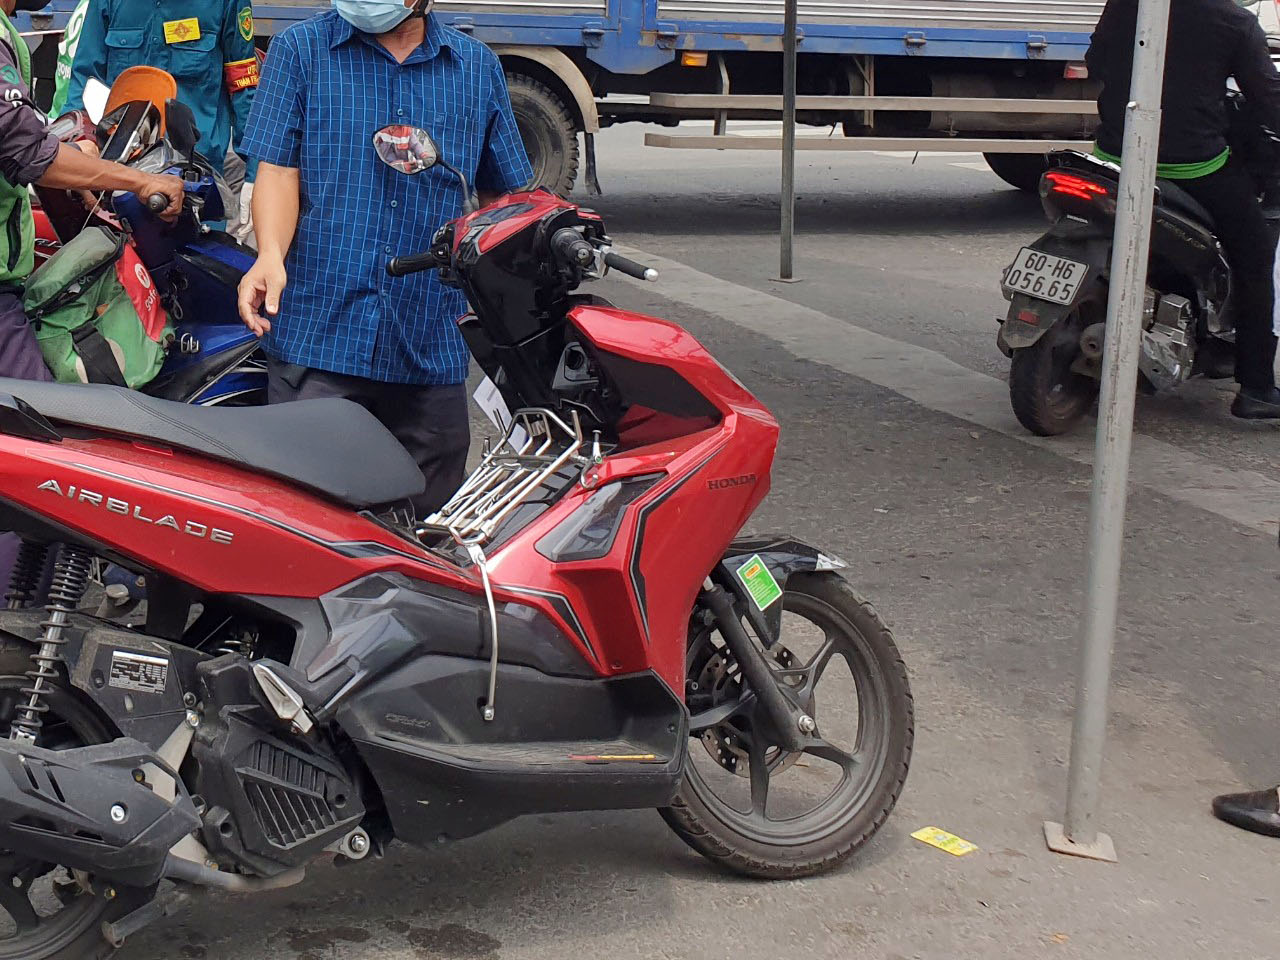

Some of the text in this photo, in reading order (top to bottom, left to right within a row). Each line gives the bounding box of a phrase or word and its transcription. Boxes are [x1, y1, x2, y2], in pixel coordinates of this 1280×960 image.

[1024, 252, 1076, 280] 60-H6
[1008, 272, 1074, 301] 056.65
[707, 473, 757, 490] HONDA
[37, 479, 234, 545] AIRBLADE
